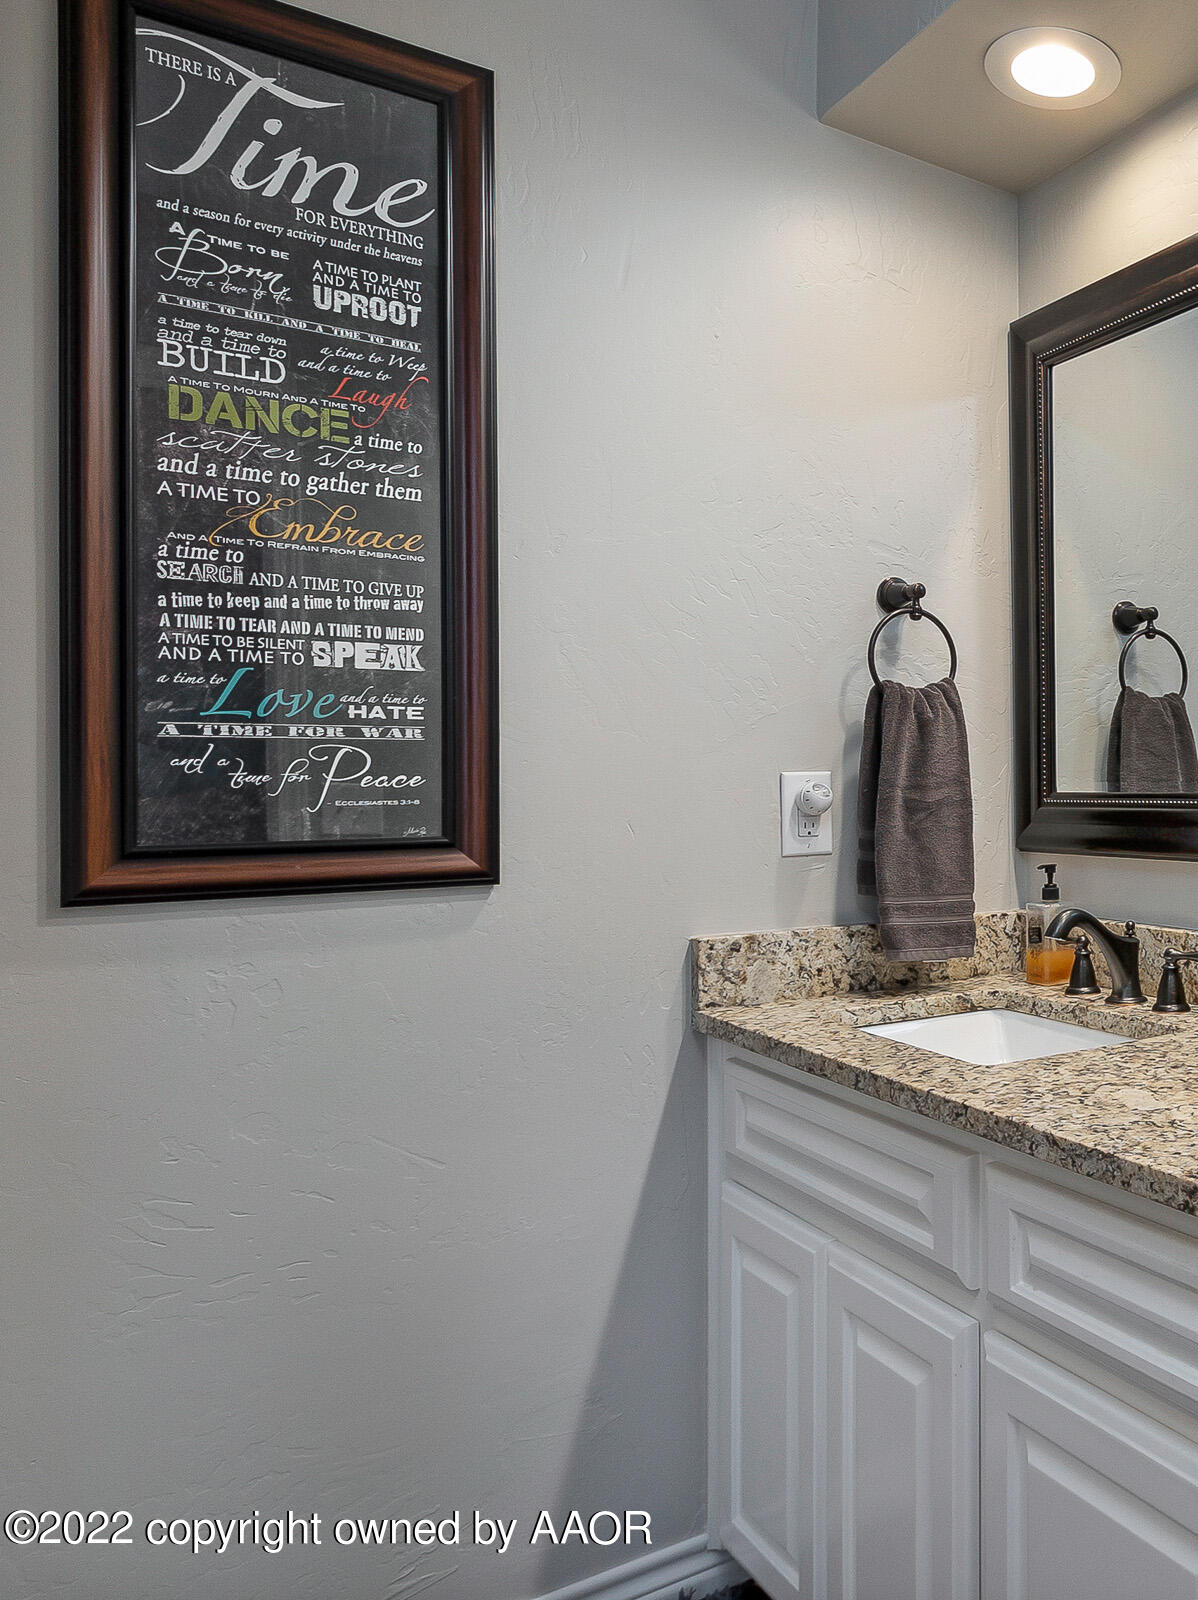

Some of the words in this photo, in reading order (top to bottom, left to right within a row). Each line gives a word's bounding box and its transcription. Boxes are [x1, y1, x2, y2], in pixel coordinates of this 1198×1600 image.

[145, 46, 203, 77] THERE
[207, 65, 221, 82] IS
[225, 71, 237, 87] A
[135, 28, 435, 228] Time
[155, 198, 179, 212] and
[182, 203, 190, 214] a
[193, 206, 231, 223] season
[233, 213, 252, 228] for
[254, 220, 284, 238] every
[286, 226, 327, 247] activity
[330, 235, 361, 253] under
[364, 242, 381, 257] the
[383, 248, 423, 267] heavens
[168, 221, 186, 235] A
[295, 207, 326, 229] FOR
[330, 215, 425, 250] EVERYTHING
[155, 228, 290, 295] Born
[312, 260, 323, 271] A
[325, 261, 358, 279] TIME
[360, 269, 378, 283] TO
[382, 274, 422, 291] PLANT
[177, 272, 204, 289] and
[207, 279, 215, 287] a
[220, 273, 248, 294] time
[250, 279, 267, 300] to
[273, 286, 293, 305] die
[312, 271, 345, 287] AND
[349, 279, 360, 290] A
[363, 282, 399, 298] TIME
[403, 289, 422, 304] TO
[312, 284, 422, 328] UPROOT
[158, 294, 168, 303] A
[177, 296, 210, 311] TIME
[218, 303, 237, 315] TO
[244, 309, 274, 323] KILL
[282, 317, 307, 330] AND
[315, 324, 324, 333] A
[332, 326, 361, 341] TIME
[367, 333, 385, 344] TO
[391, 339, 422, 352] HEAL
[158, 316, 167, 325] a
[172, 317, 201, 331] time
[205, 323, 220, 334] to
[224, 326, 253, 339] tear
[256, 333, 287, 346] down
[156, 328, 194, 344] and
[200, 336, 212, 346] a
[222, 336, 260, 355] time
[269, 345, 287, 360] to
[156, 338, 286, 384] BUILD
[298, 354, 335, 371] and
[328, 363, 340, 373] a
[343, 365, 372, 380] time
[376, 369, 392, 381] to
[320, 346, 331, 355] a
[335, 347, 365, 361] time
[368, 353, 385, 363] to
[389, 354, 428, 382] Weep
[168, 383, 350, 444] DANCE
[328, 376, 429, 429] Laugh
[156, 430, 303, 462] scatter
[313, 444, 424, 479] stones
[354, 435, 362, 446] a
[368, 433, 403, 452] time
[407, 440, 422, 455] to
[156, 453, 199, 476] and
[206, 463, 218, 477] a
[225, 461, 273, 484] time
[280, 469, 300, 488] to
[305, 471, 370, 496] gather
[375, 477, 422, 502] them
[156, 480, 173, 496] A
[176, 482, 228, 502] TIME
[234, 488, 261, 506] TO
[198, 534, 208, 542] A
[208, 493, 425, 552] Embrace
[158, 544, 168, 557] a
[175, 541, 219, 561] time
[225, 546, 244, 563] to
[156, 560, 244, 585] SEARCH
[249, 573, 284, 588] AND
[287, 575, 299, 589] A
[301, 576, 340, 592] TIME
[343, 579, 364, 594] TO
[368, 581, 402, 598] GIVE
[406, 584, 425, 598] UP
[158, 594, 167, 607] a
[171, 592, 203, 608] time
[207, 593, 222, 609] to
[226, 592, 260, 611] keep
[263, 595, 288, 609] and
[291, 598, 300, 609] a
[303, 594, 333, 610] time
[336, 597, 350, 611] to
[353, 595, 390, 611] throw
[393, 599, 424, 613] away
[158, 632, 169, 644] A
[172, 633, 210, 646] TIME
[212, 634, 233, 647] TO
[237, 636, 255, 648] BE
[257, 637, 305, 651] SILENT
[159, 613, 171, 628] A
[174, 613, 213, 630] TIME
[216, 615, 236, 630] TO
[239, 617, 276, 634] TEAR
[280, 619, 310, 635] AND
[314, 622, 325, 636] A
[328, 622, 362, 639] TIME
[365, 625, 382, 640] TO
[384, 627, 425, 642] MEND
[158, 646, 201, 661] AND
[208, 647, 222, 662] A
[227, 649, 274, 664] TIME
[280, 651, 305, 666] TO
[311, 640, 425, 672] SPEAK
[156, 674, 169, 683] a
[173, 672, 205, 685] time
[209, 674, 227, 685] to
[200, 667, 343, 720] Love
[339, 685, 374, 703] and
[366, 695, 377, 704] a
[382, 693, 408, 705] time
[412, 695, 428, 705] to
[348, 705, 425, 721] HATE
[158, 724, 180, 736] A
[198, 724, 272, 737] TIME
[288, 726, 346, 738] FOR
[360, 727, 424, 739] WAR
[170, 743, 215, 775] and
[216, 758, 230, 767] a
[227, 757, 272, 789] time
[268, 758, 312, 797] for
[306, 744, 426, 813] Peace
